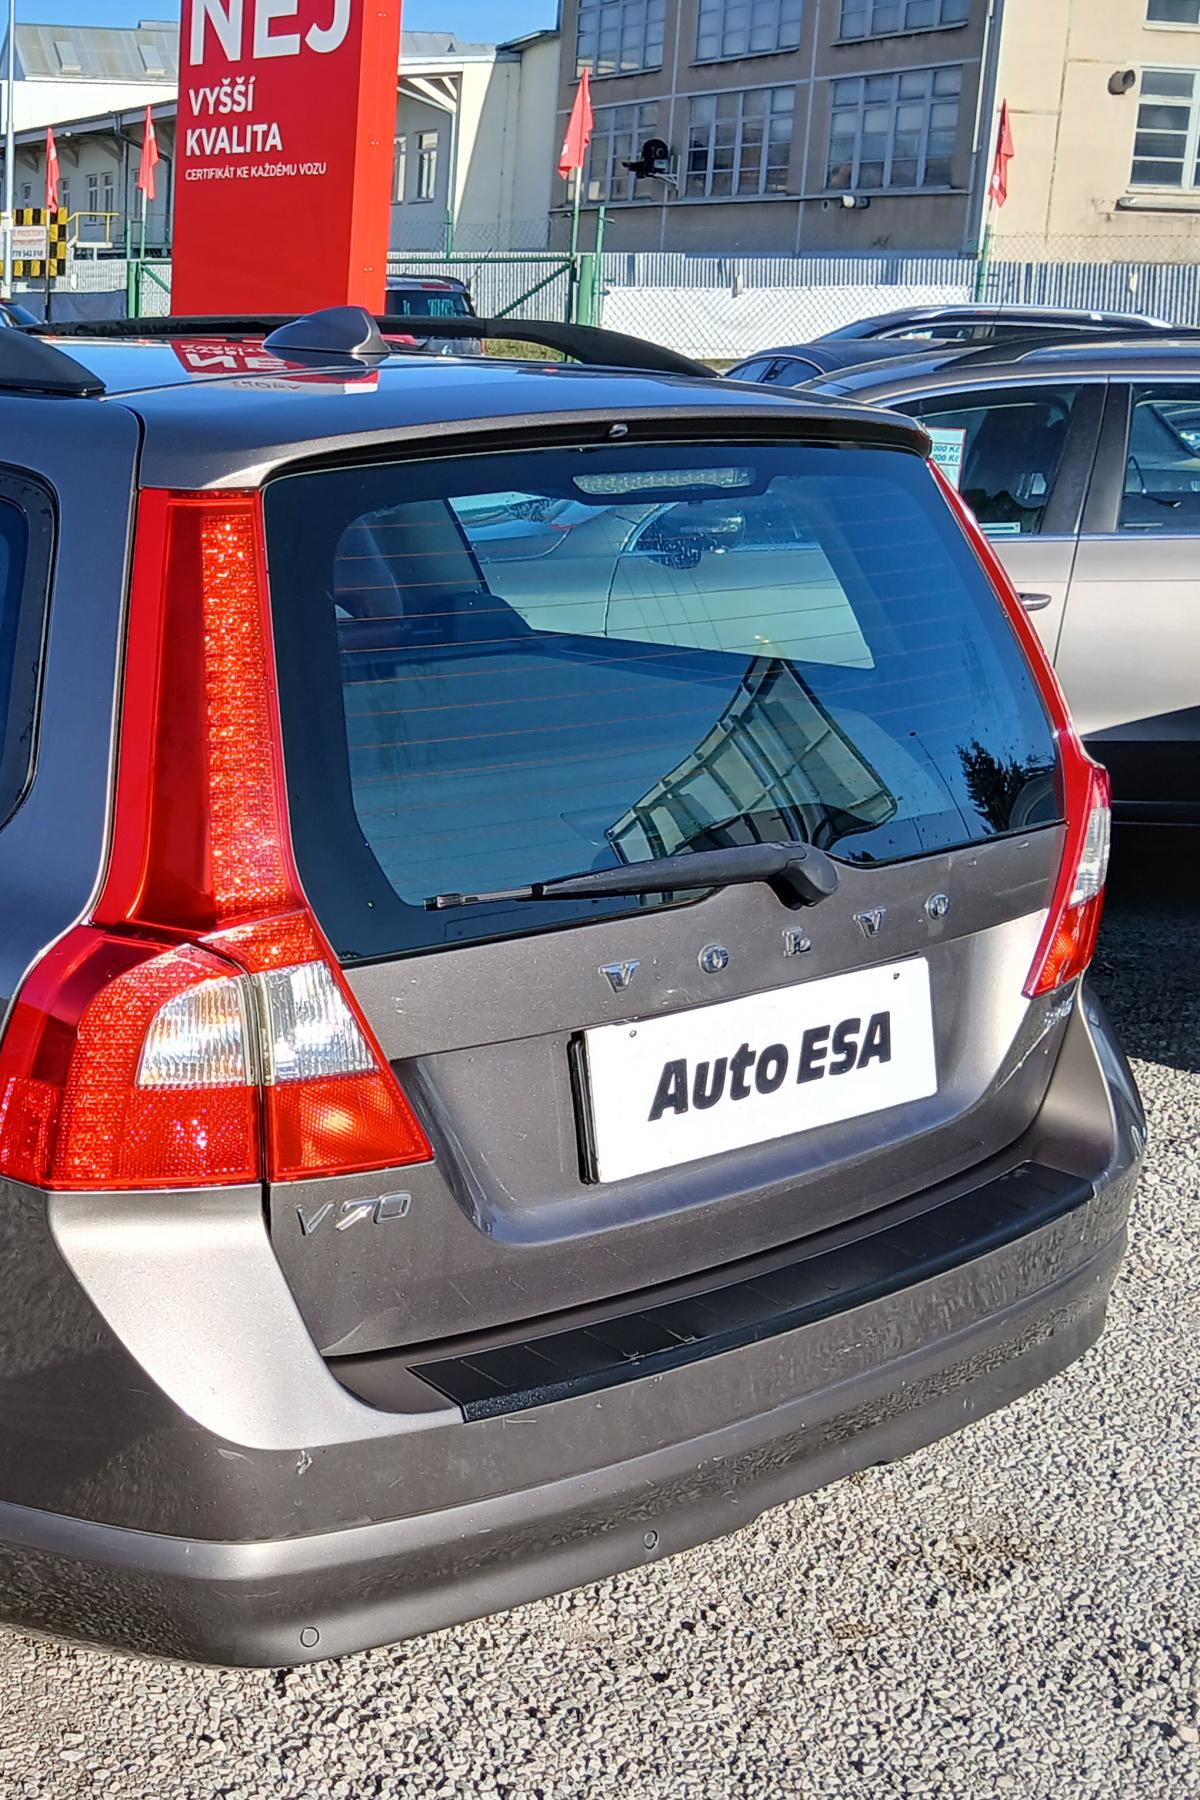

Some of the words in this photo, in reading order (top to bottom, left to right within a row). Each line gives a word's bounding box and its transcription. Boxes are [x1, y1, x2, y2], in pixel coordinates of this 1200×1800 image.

[189, 0, 351, 66] NEJ
[188, 75, 256, 117] VYŠŠÍ
[186, 122, 283, 157] KVALITA
[185, 165, 235, 181] CERTIFIKÁT
[236, 166, 249, 179] KE
[250, 162, 297, 178] KAŽDÉMU
[299, 162, 327, 175] VOZU
[597, 893, 951, 994] VOLVO
[647, 1042, 789, 1122] Auto
[796, 1011, 892, 1085] ESA
[295, 1190, 412, 1237] V70
